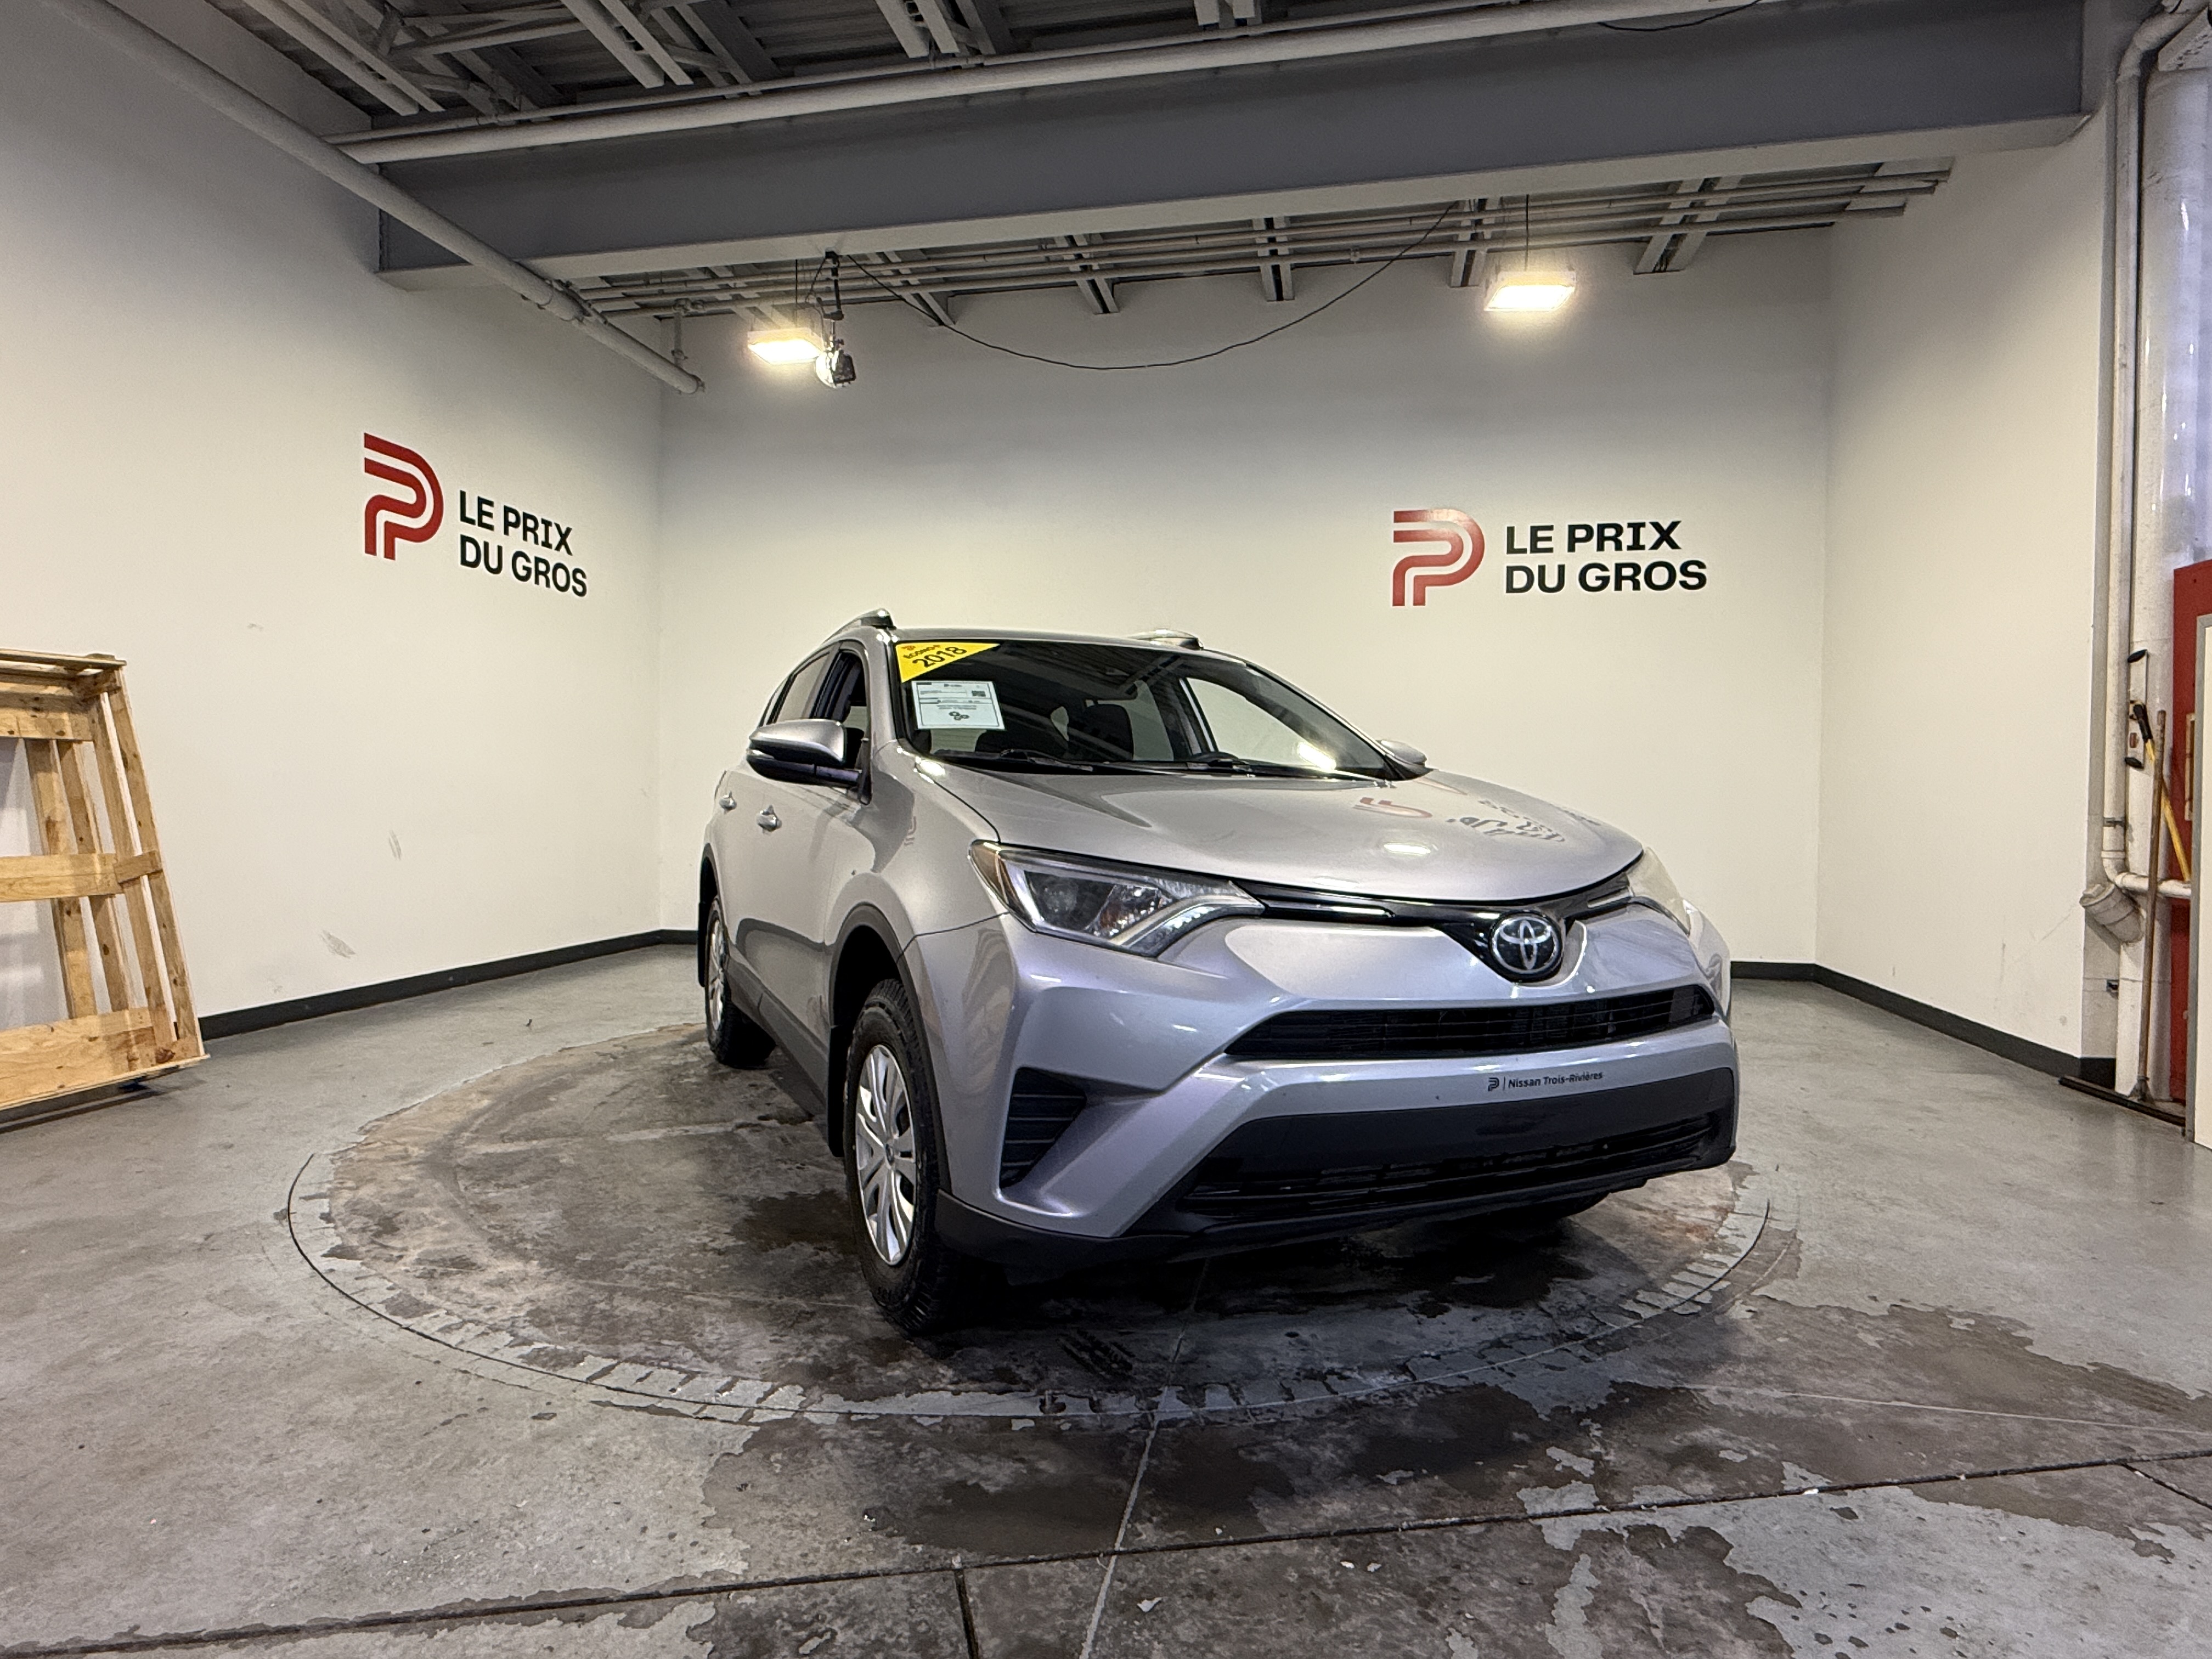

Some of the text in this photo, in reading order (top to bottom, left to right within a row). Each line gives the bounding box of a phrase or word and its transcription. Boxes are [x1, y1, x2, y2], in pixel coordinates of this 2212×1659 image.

[460, 489, 573, 556] LE PRIX
[1506, 520, 1682, 555] LE PRIX
[460, 534, 587, 597] DU GROS
[1505, 560, 1707, 594] DU GROS
[912, 646, 967, 668] 2018
[1508, 1078, 1541, 1089] Nissan
[1543, 1071, 1603, 1085] Trois-Rivières
